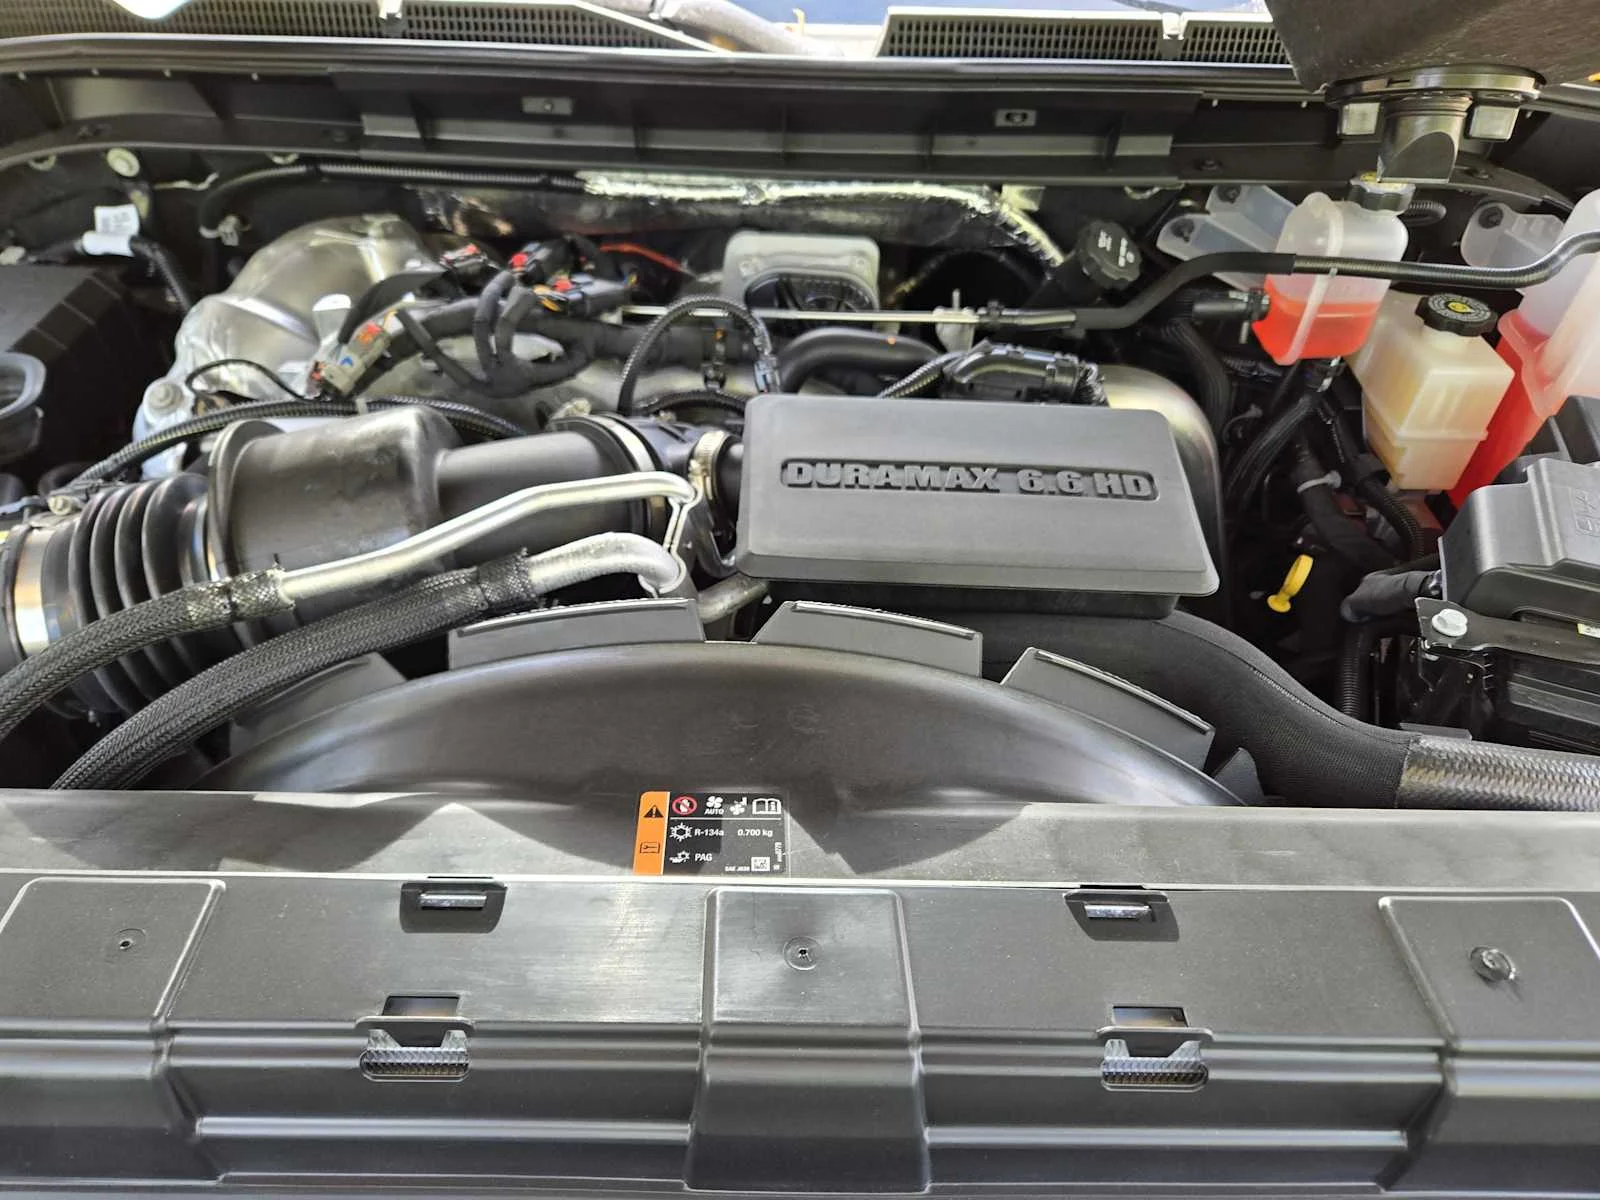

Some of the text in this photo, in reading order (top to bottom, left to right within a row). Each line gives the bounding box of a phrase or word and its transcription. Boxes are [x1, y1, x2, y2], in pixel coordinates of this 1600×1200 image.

[787, 461, 1153, 498] DURAMAX 6.6 HD
[762, 829, 773, 837] kg
[695, 853, 713, 862] PAG
